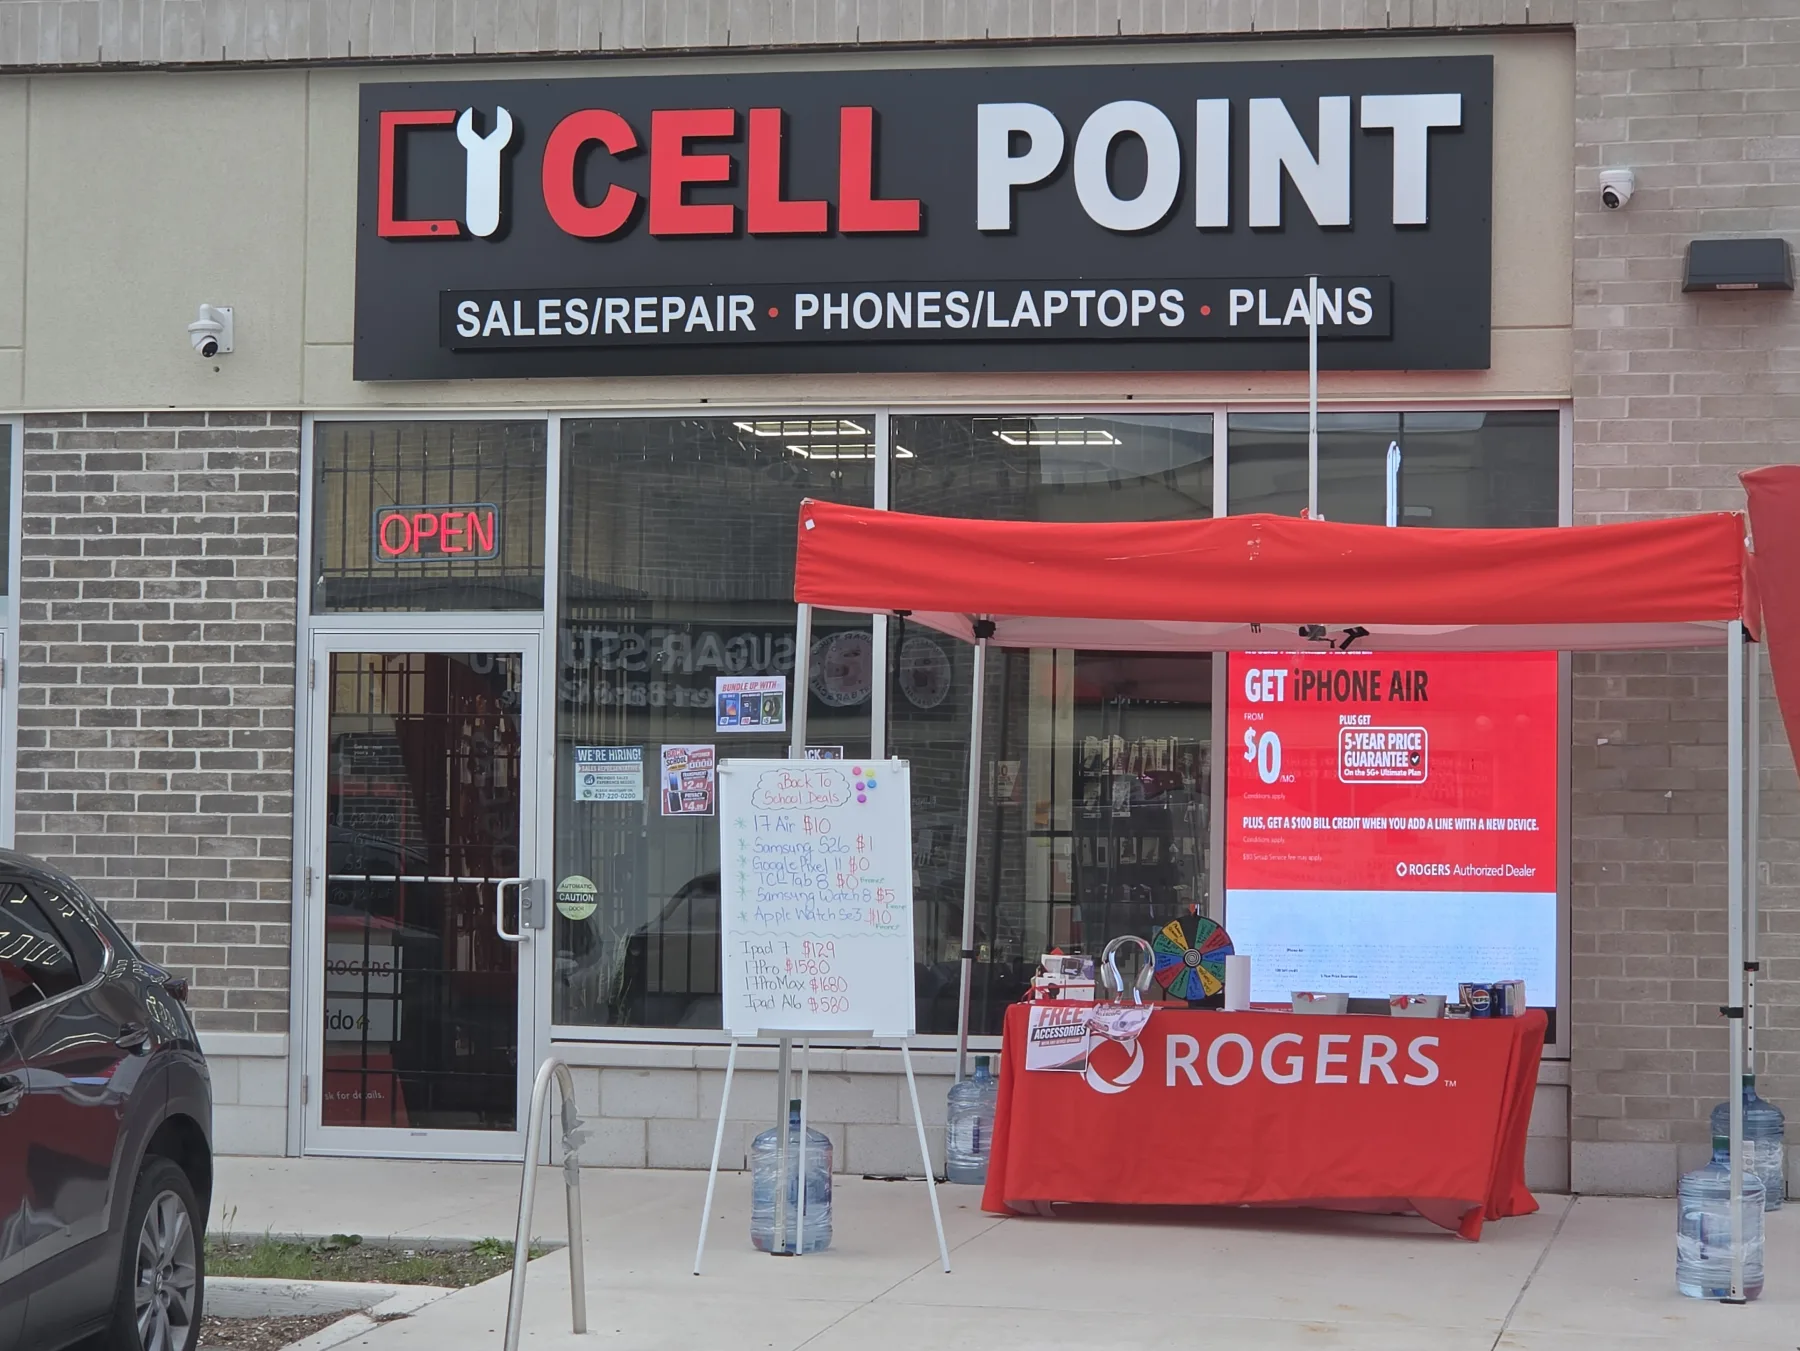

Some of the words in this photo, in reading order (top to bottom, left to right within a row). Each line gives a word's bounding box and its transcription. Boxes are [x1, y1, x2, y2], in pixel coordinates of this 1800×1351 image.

[542, 106, 921, 237] CELL
[977, 93, 1462, 231] POINT
[456, 295, 757, 338] SALES/REPAIR
[795, 289, 1186, 331] PHONES/LAPTOPS
[1229, 286, 1373, 326] PLANS
[380, 511, 494, 555] OPEN
[722, 682, 748, 692] BUNDLE
[749, 682, 759, 690] UP
[760, 681, 777, 689] WITH
[1245, 668, 1288, 702] GET
[1294, 668, 1382, 702] iPHONE
[1388, 669, 1429, 702] AIR
[1244, 712, 1264, 721] FROM
[1339, 714, 1357, 725] PLUS
[1357, 714, 1371, 725] GET
[1344, 732, 1386, 750] 5-YEAR
[1387, 733, 1422, 750] PRICE
[577, 749, 606, 762] WE'RE
[608, 748, 642, 761] HIRING!
[804, 749, 821, 760] ACK
[1244, 726, 1282, 784] $0
[1344, 751, 1409, 768] GUARANTEE
[777, 772, 814, 790] Back
[815, 772, 832, 788] To
[1344, 768, 1353, 776] On
[1354, 768, 1366, 776] the
[1366, 768, 1380, 777] 5G+
[1380, 768, 1407, 777] Ultimate
[1407, 768, 1422, 777] Plan
[763, 790, 802, 805] School
[805, 791, 840, 805] Deals
[754, 815, 771, 832] 17
[776, 816, 796, 833] Air
[802, 814, 832, 836] $10
[1242, 816, 1266, 830] PLUS,
[1267, 816, 1283, 829] GET
[1283, 817, 1290, 829] A
[1291, 816, 1312, 829] $100
[1313, 817, 1331, 830] BILL
[1332, 817, 1361, 829] CREDIT
[1361, 817, 1388, 830] WHEN
[1388, 817, 1406, 830] YOU
[1407, 818, 1426, 830] ADD
[1426, 818, 1434, 830] A
[1434, 818, 1453, 830] LINE
[1454, 818, 1477, 830] WITH
[1477, 818, 1485, 830] A
[1486, 818, 1506, 831] NEW
[1506, 818, 1540, 831] DEVICE.
[753, 836, 813, 860] Samsung
[817, 836, 850, 854] S26
[752, 855, 798, 877] Google
[800, 856, 829, 875] Pixel
[849, 855, 870, 875] $0
[1409, 863, 1450, 876] ROGERS
[1453, 862, 1503, 877] Authorized
[1505, 864, 1536, 877] Dealer
[787, 872, 813, 887] Tab
[816, 874, 829, 890] 8
[836, 872, 859, 889] $0
[559, 893, 594, 902] CAUTION
[756, 887, 815, 907] Samsung
[819, 889, 859, 903] Watch
[862, 888, 872, 902] 8
[875, 887, 895, 904] $5
[754, 906, 792, 927] Apple
[795, 907, 836, 922] Watch
[739, 940, 773, 959] Ipad
[802, 940, 835, 958] $129
[326, 960, 391, 977] ROGRS
[784, 958, 830, 976] $1580
[809, 976, 848, 994] $1680
[742, 994, 775, 1012] Ipad
[807, 996, 849, 1014] $580
[1039, 1007, 1084, 1026] FREE
[1033, 1026, 1086, 1040] ACCESSORIES
[1165, 1033, 1440, 1087] ROGERS
[352, 1091, 385, 1099] deails.
